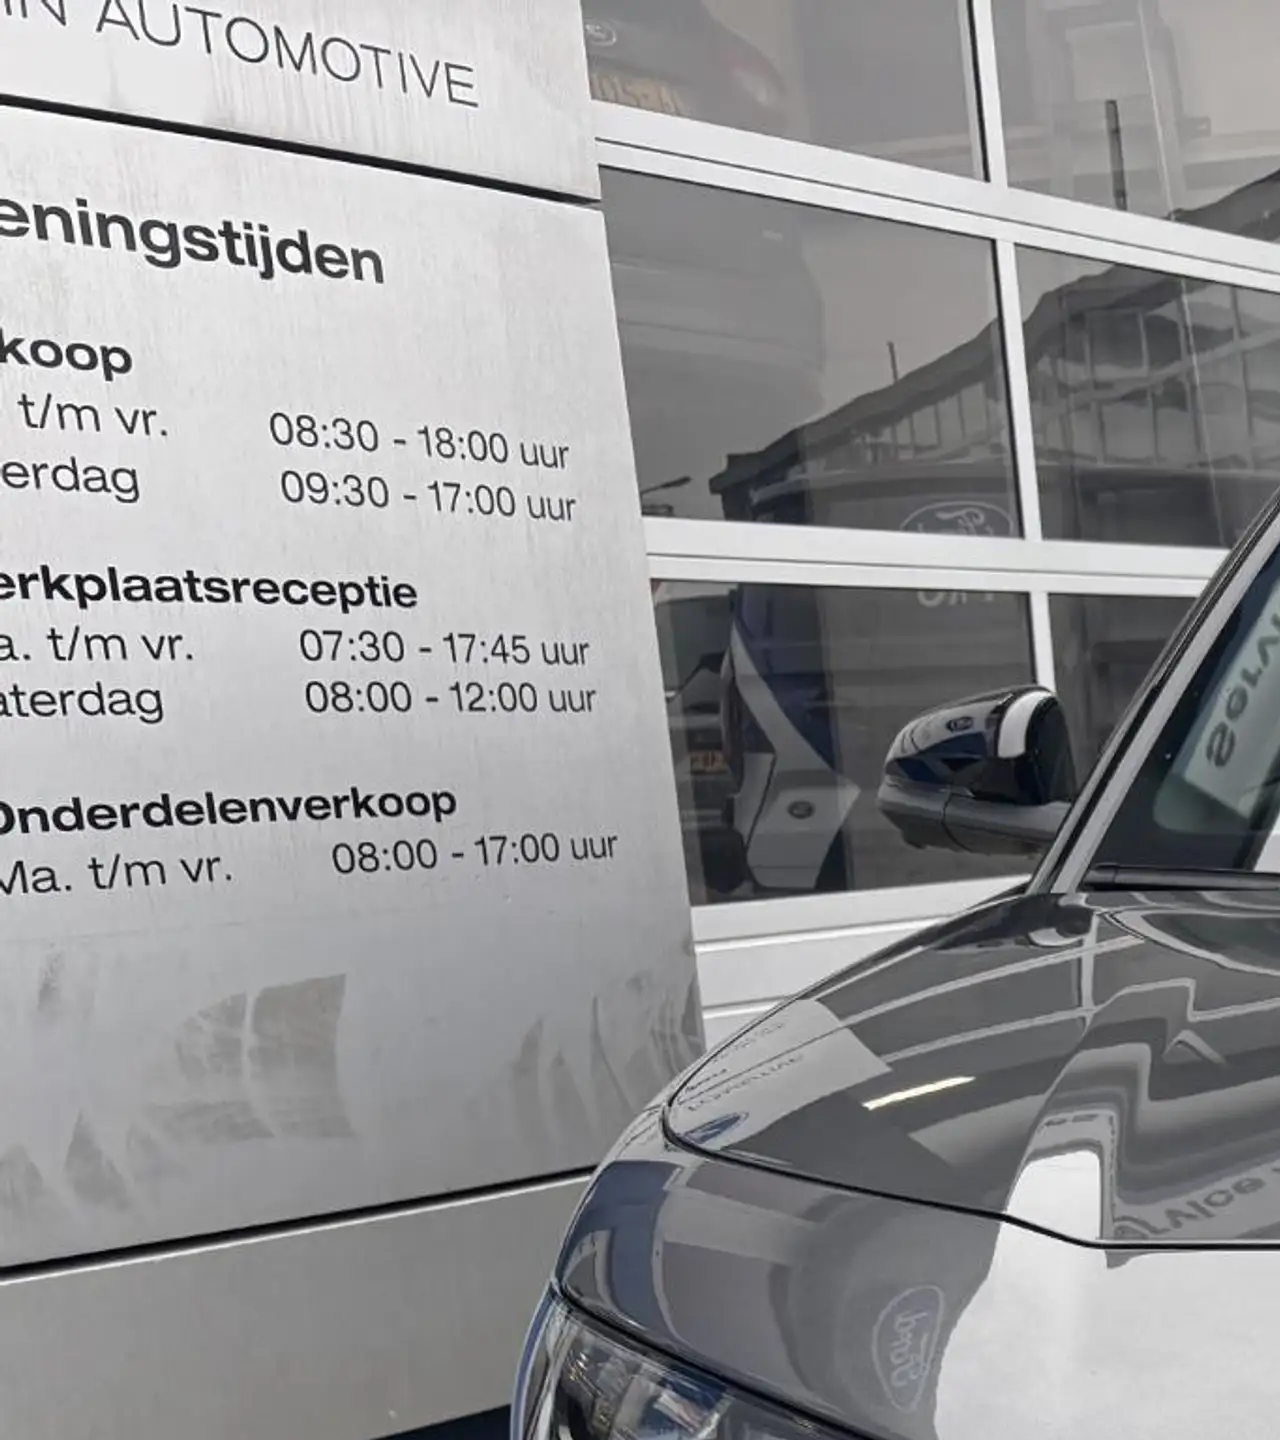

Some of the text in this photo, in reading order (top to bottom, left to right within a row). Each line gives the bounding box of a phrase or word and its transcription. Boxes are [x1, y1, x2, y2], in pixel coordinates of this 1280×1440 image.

[95, 0, 478, 108] AUTOMOTIVE
[0, 197, 384, 284] eningstijden
[0, 328, 133, 382] koop
[17, 393, 101, 432] t/m
[114, 407, 168, 437] vr.
[269, 412, 379, 453] 08:30
[417, 425, 509, 464] 18:00
[520, 442, 570, 469] uur
[1, 456, 140, 504] erdag
[281, 470, 389, 508] 09:30
[427, 480, 516, 517] 17:00
[526, 495, 576, 521] uur
[46, 625, 127, 661] t/m
[141, 634, 193, 661] vr.
[299, 629, 405, 663] 07:30
[442, 632, 531, 664] 17:45
[541, 642, 590, 666] uur
[305, 680, 412, 713] 08:00
[449, 681, 538, 713] 12:00
[548, 689, 596, 713] uur
[87, 853, 167, 890] t/m
[180, 856, 232, 883] vr.
[332, 838, 438, 874] 08:00
[474, 832, 560, 866] 17:00
[570, 835, 618, 861] uur
